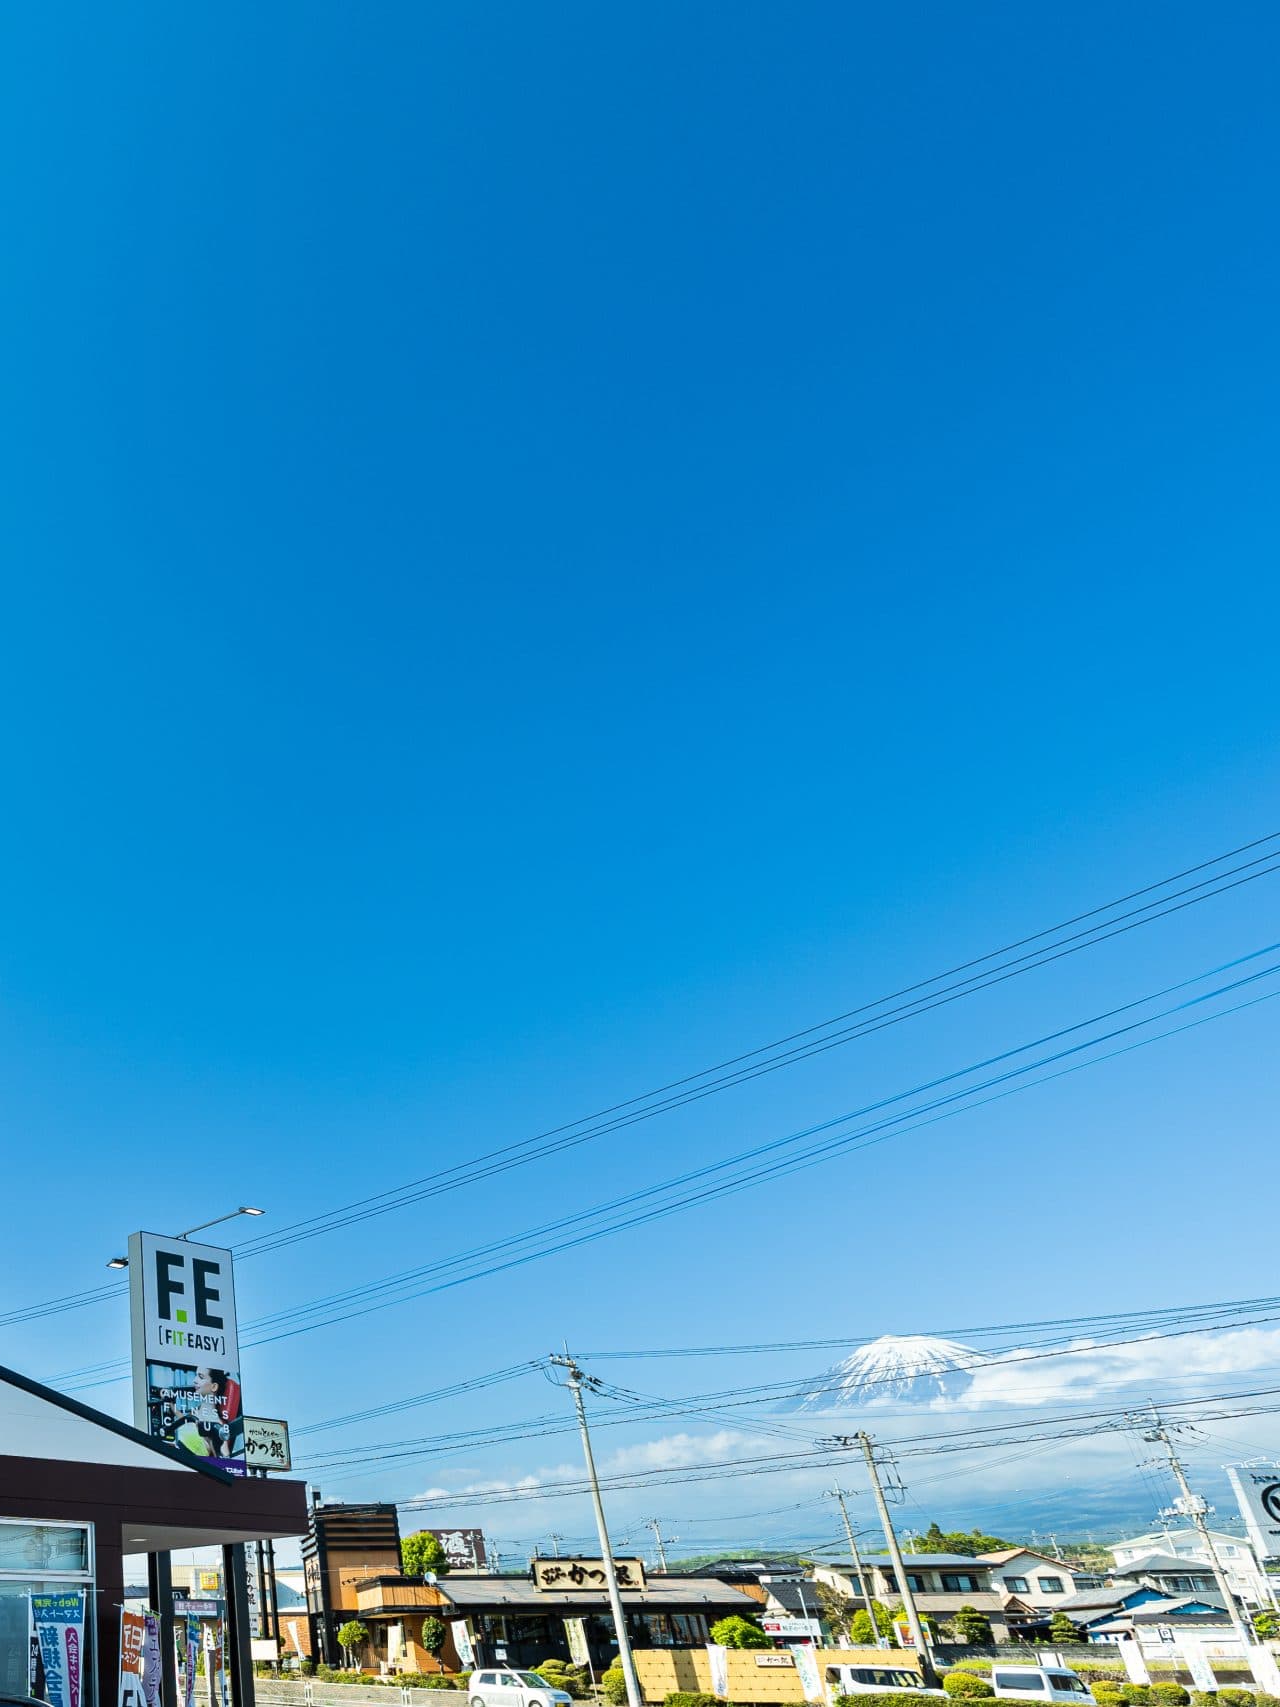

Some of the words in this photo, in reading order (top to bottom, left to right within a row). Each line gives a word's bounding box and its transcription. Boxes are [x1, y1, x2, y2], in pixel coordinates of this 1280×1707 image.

[163, 1389, 228, 1405] AMUSEMENT
[163, 1402, 230, 1420] FITNESS
[1162, 1630, 1169, 1638] P
